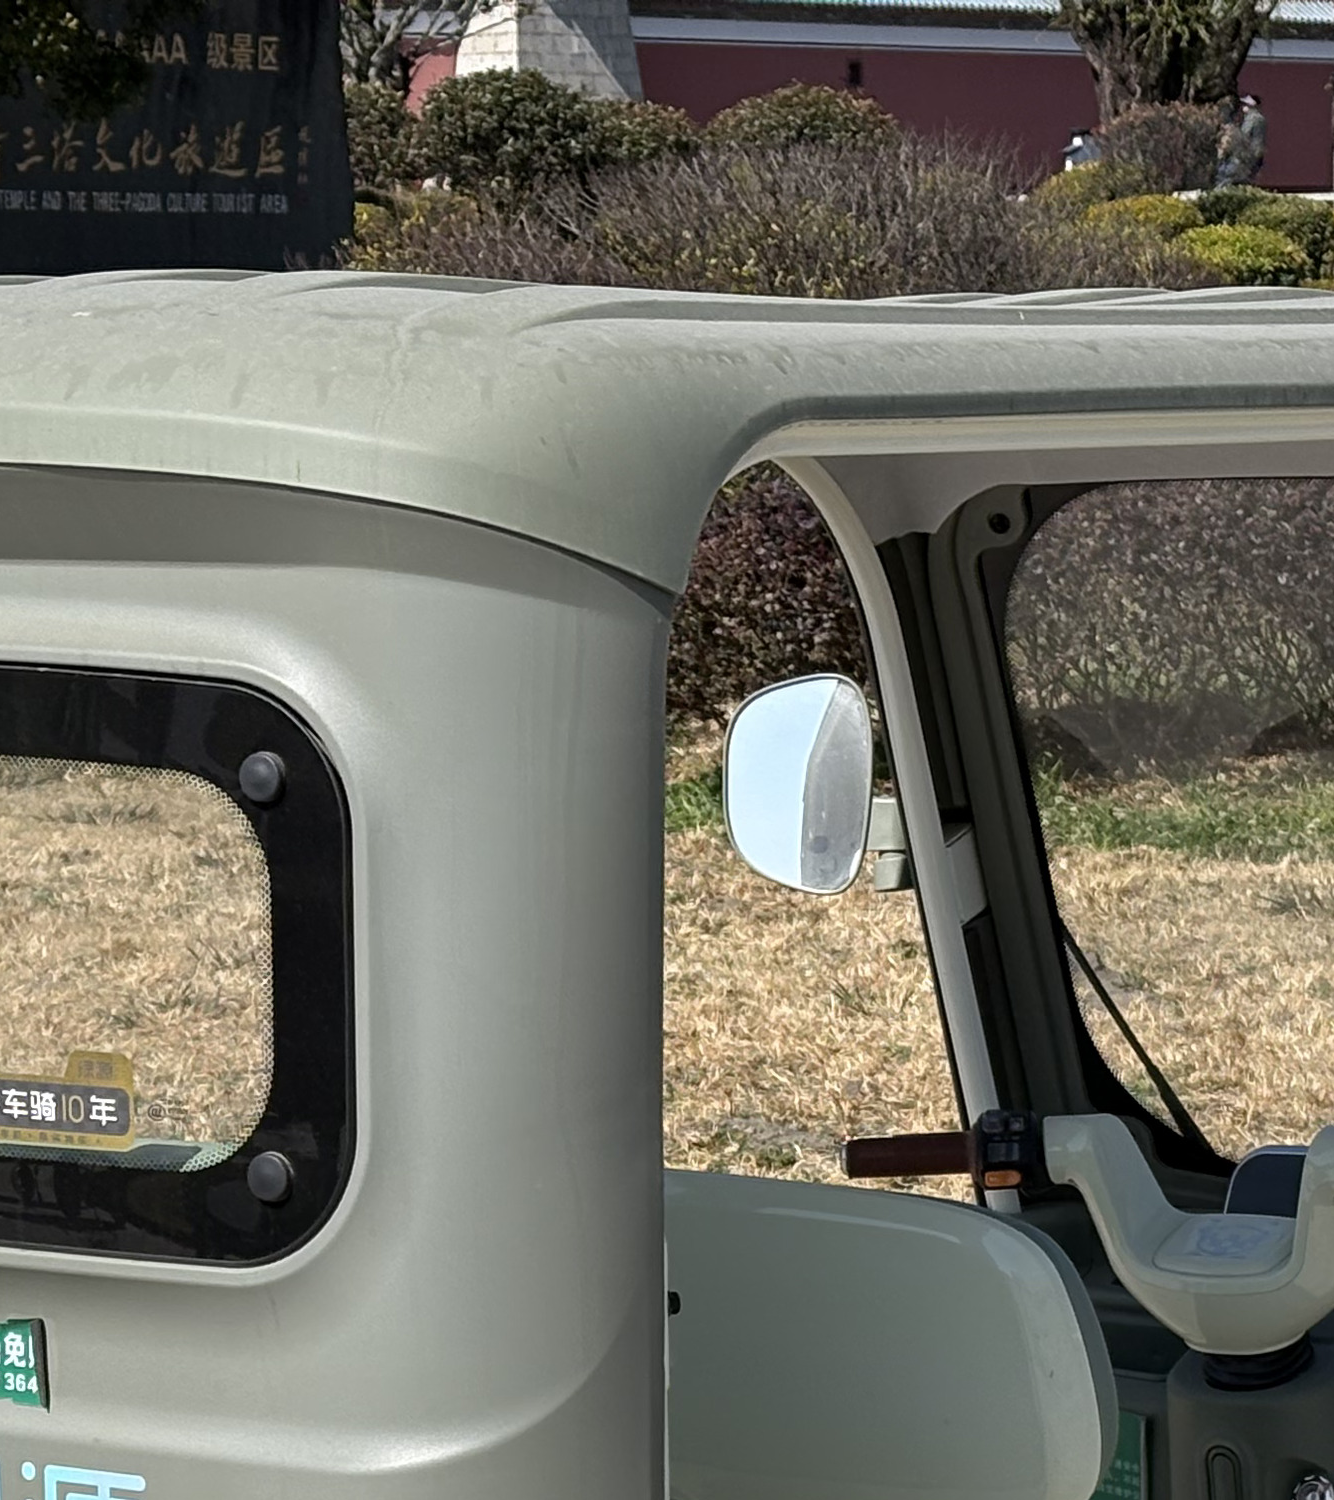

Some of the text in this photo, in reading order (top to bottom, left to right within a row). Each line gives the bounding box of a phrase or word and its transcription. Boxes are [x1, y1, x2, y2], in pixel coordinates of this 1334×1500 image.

[207, 32, 280, 71] 级景区
[42, 190, 61, 211] AND
[67, 191, 86, 212] THE
[260, 193, 289, 214] AREA
